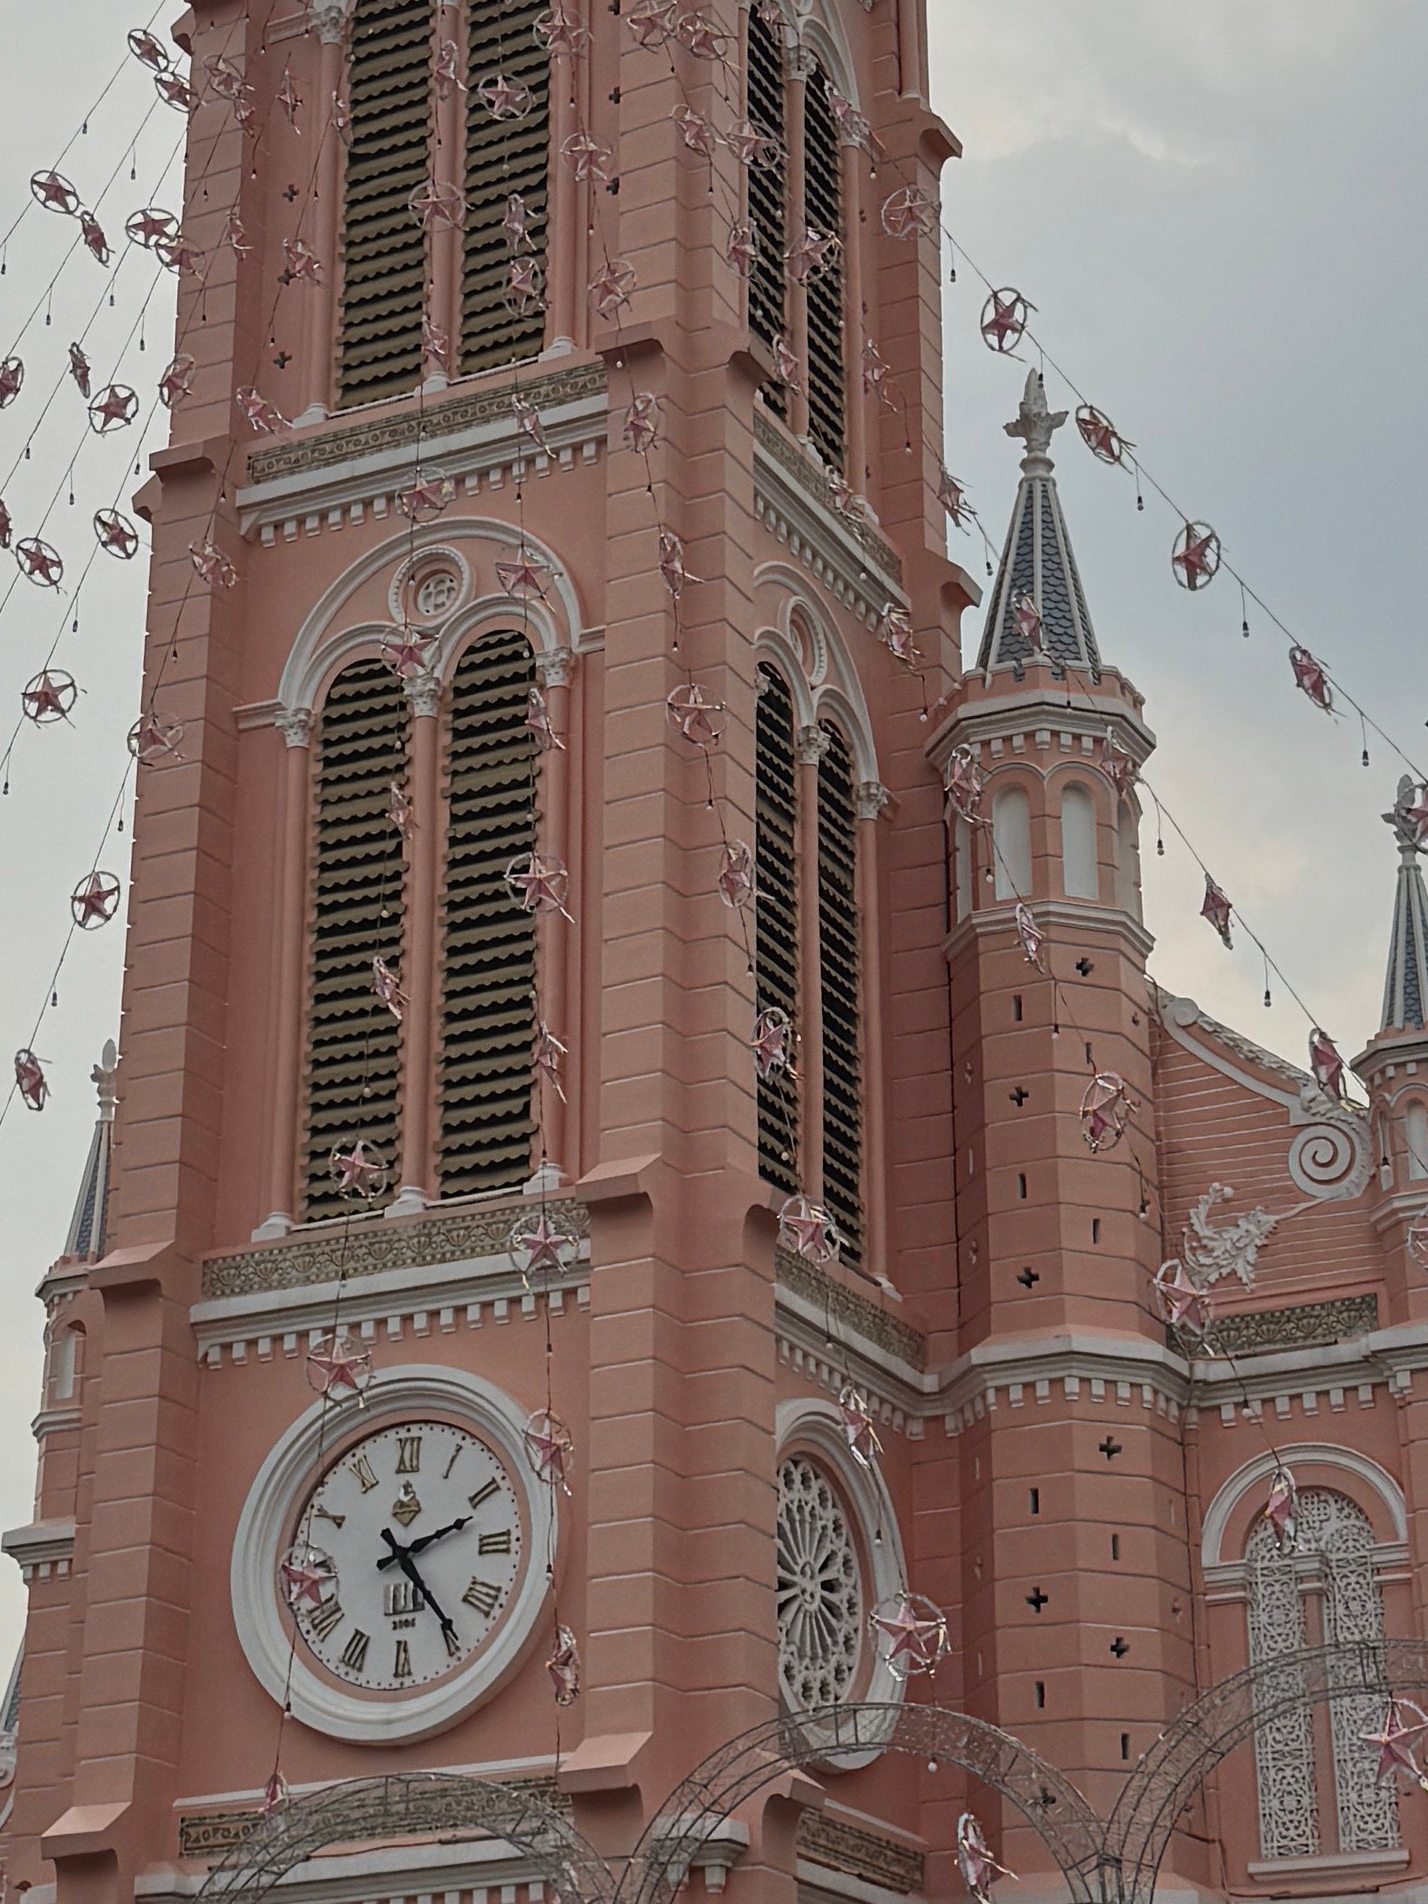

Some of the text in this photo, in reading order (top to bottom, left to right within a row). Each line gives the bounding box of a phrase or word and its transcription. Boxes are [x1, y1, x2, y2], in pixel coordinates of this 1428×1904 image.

[396, 1436, 422, 1473] XII
[468, 1477, 501, 1508] II
[478, 1529, 512, 1555] III
